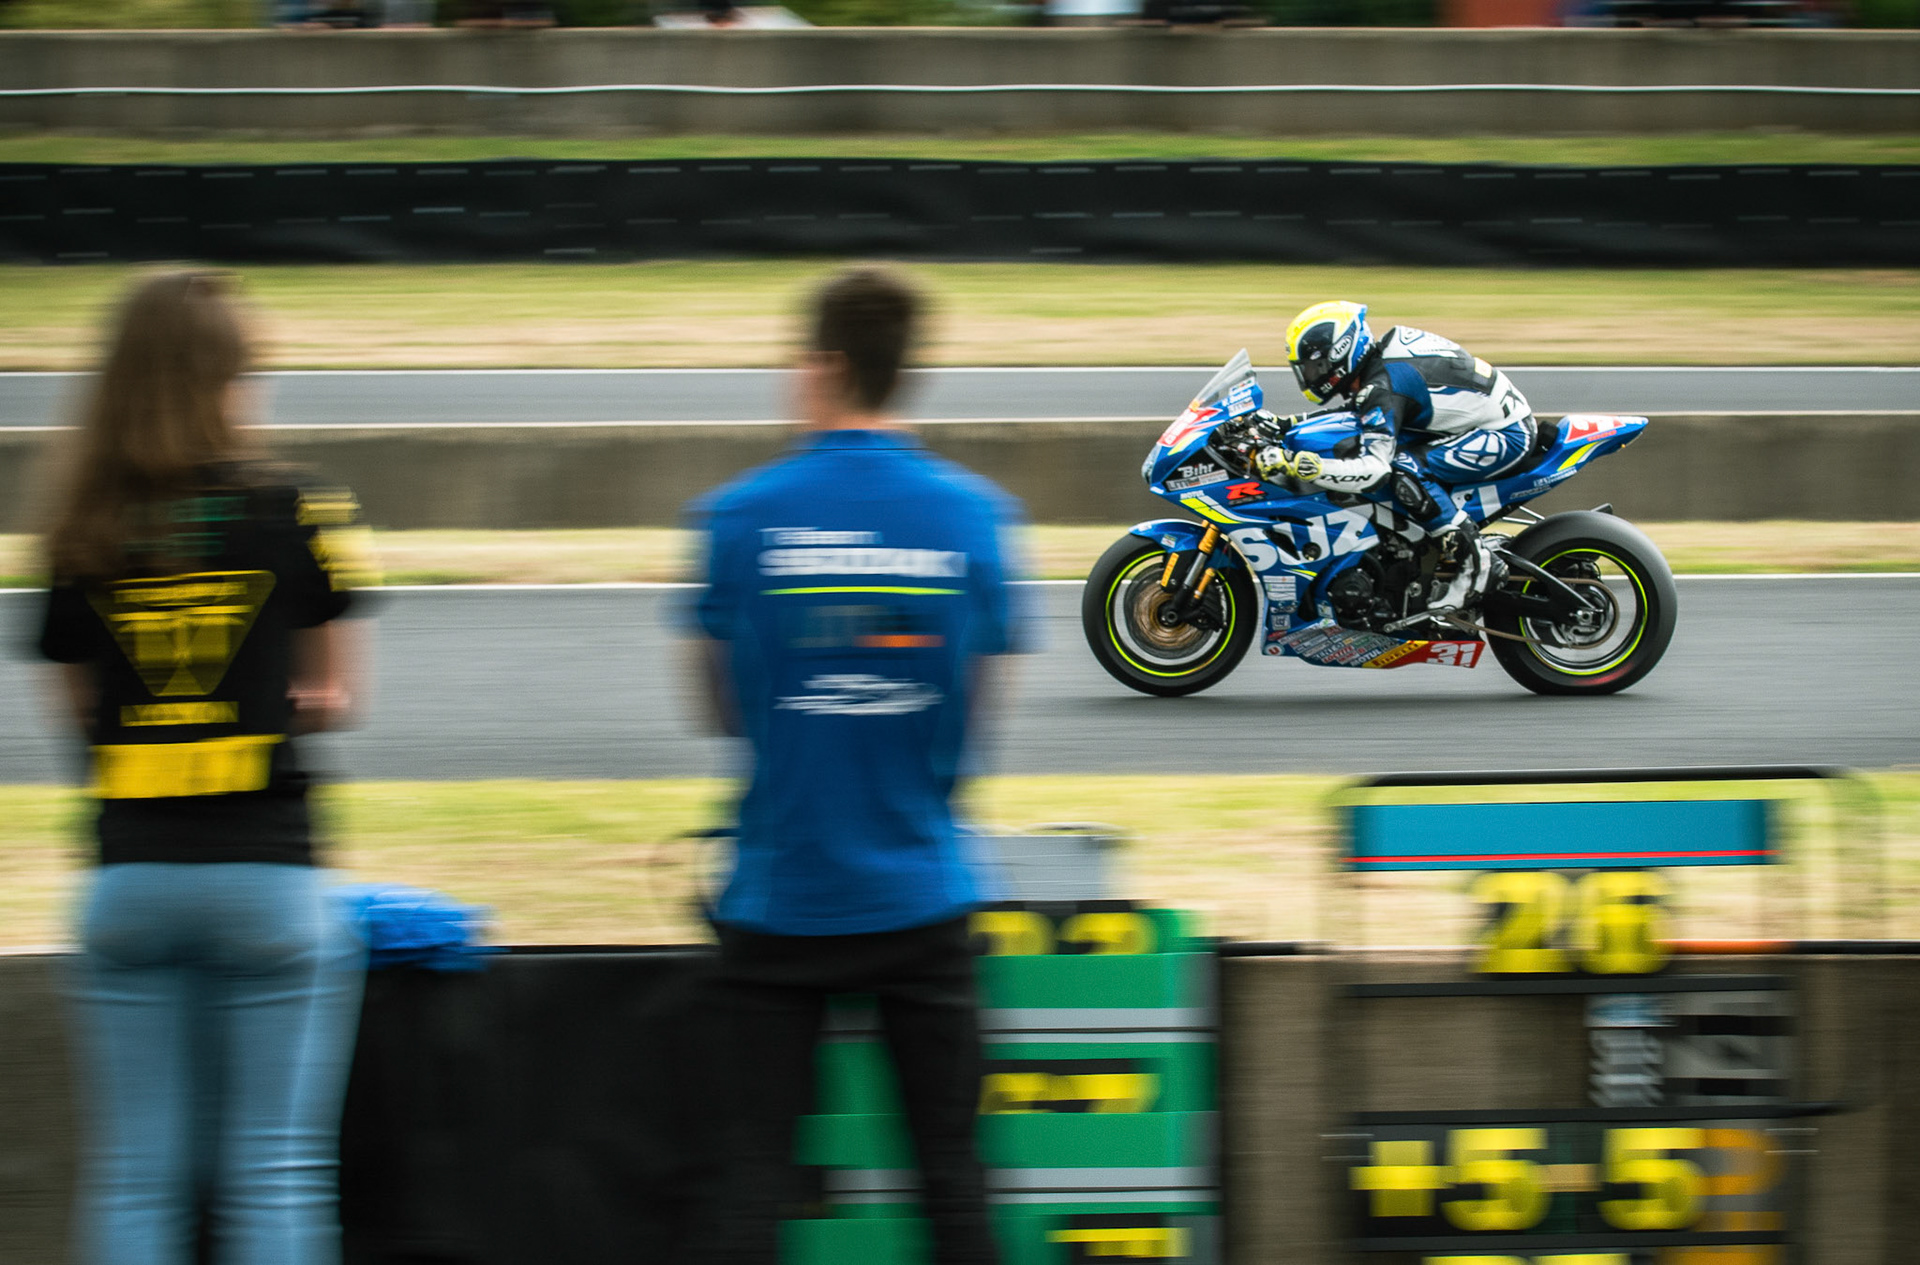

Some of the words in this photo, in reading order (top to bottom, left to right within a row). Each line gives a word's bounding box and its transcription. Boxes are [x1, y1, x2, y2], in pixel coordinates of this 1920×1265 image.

[1177, 463, 1215, 478] Bihr
[1226, 481, 1266, 500] R
[1425, 642, 1477, 667] 31
[1472, 871, 1666, 975] 26
